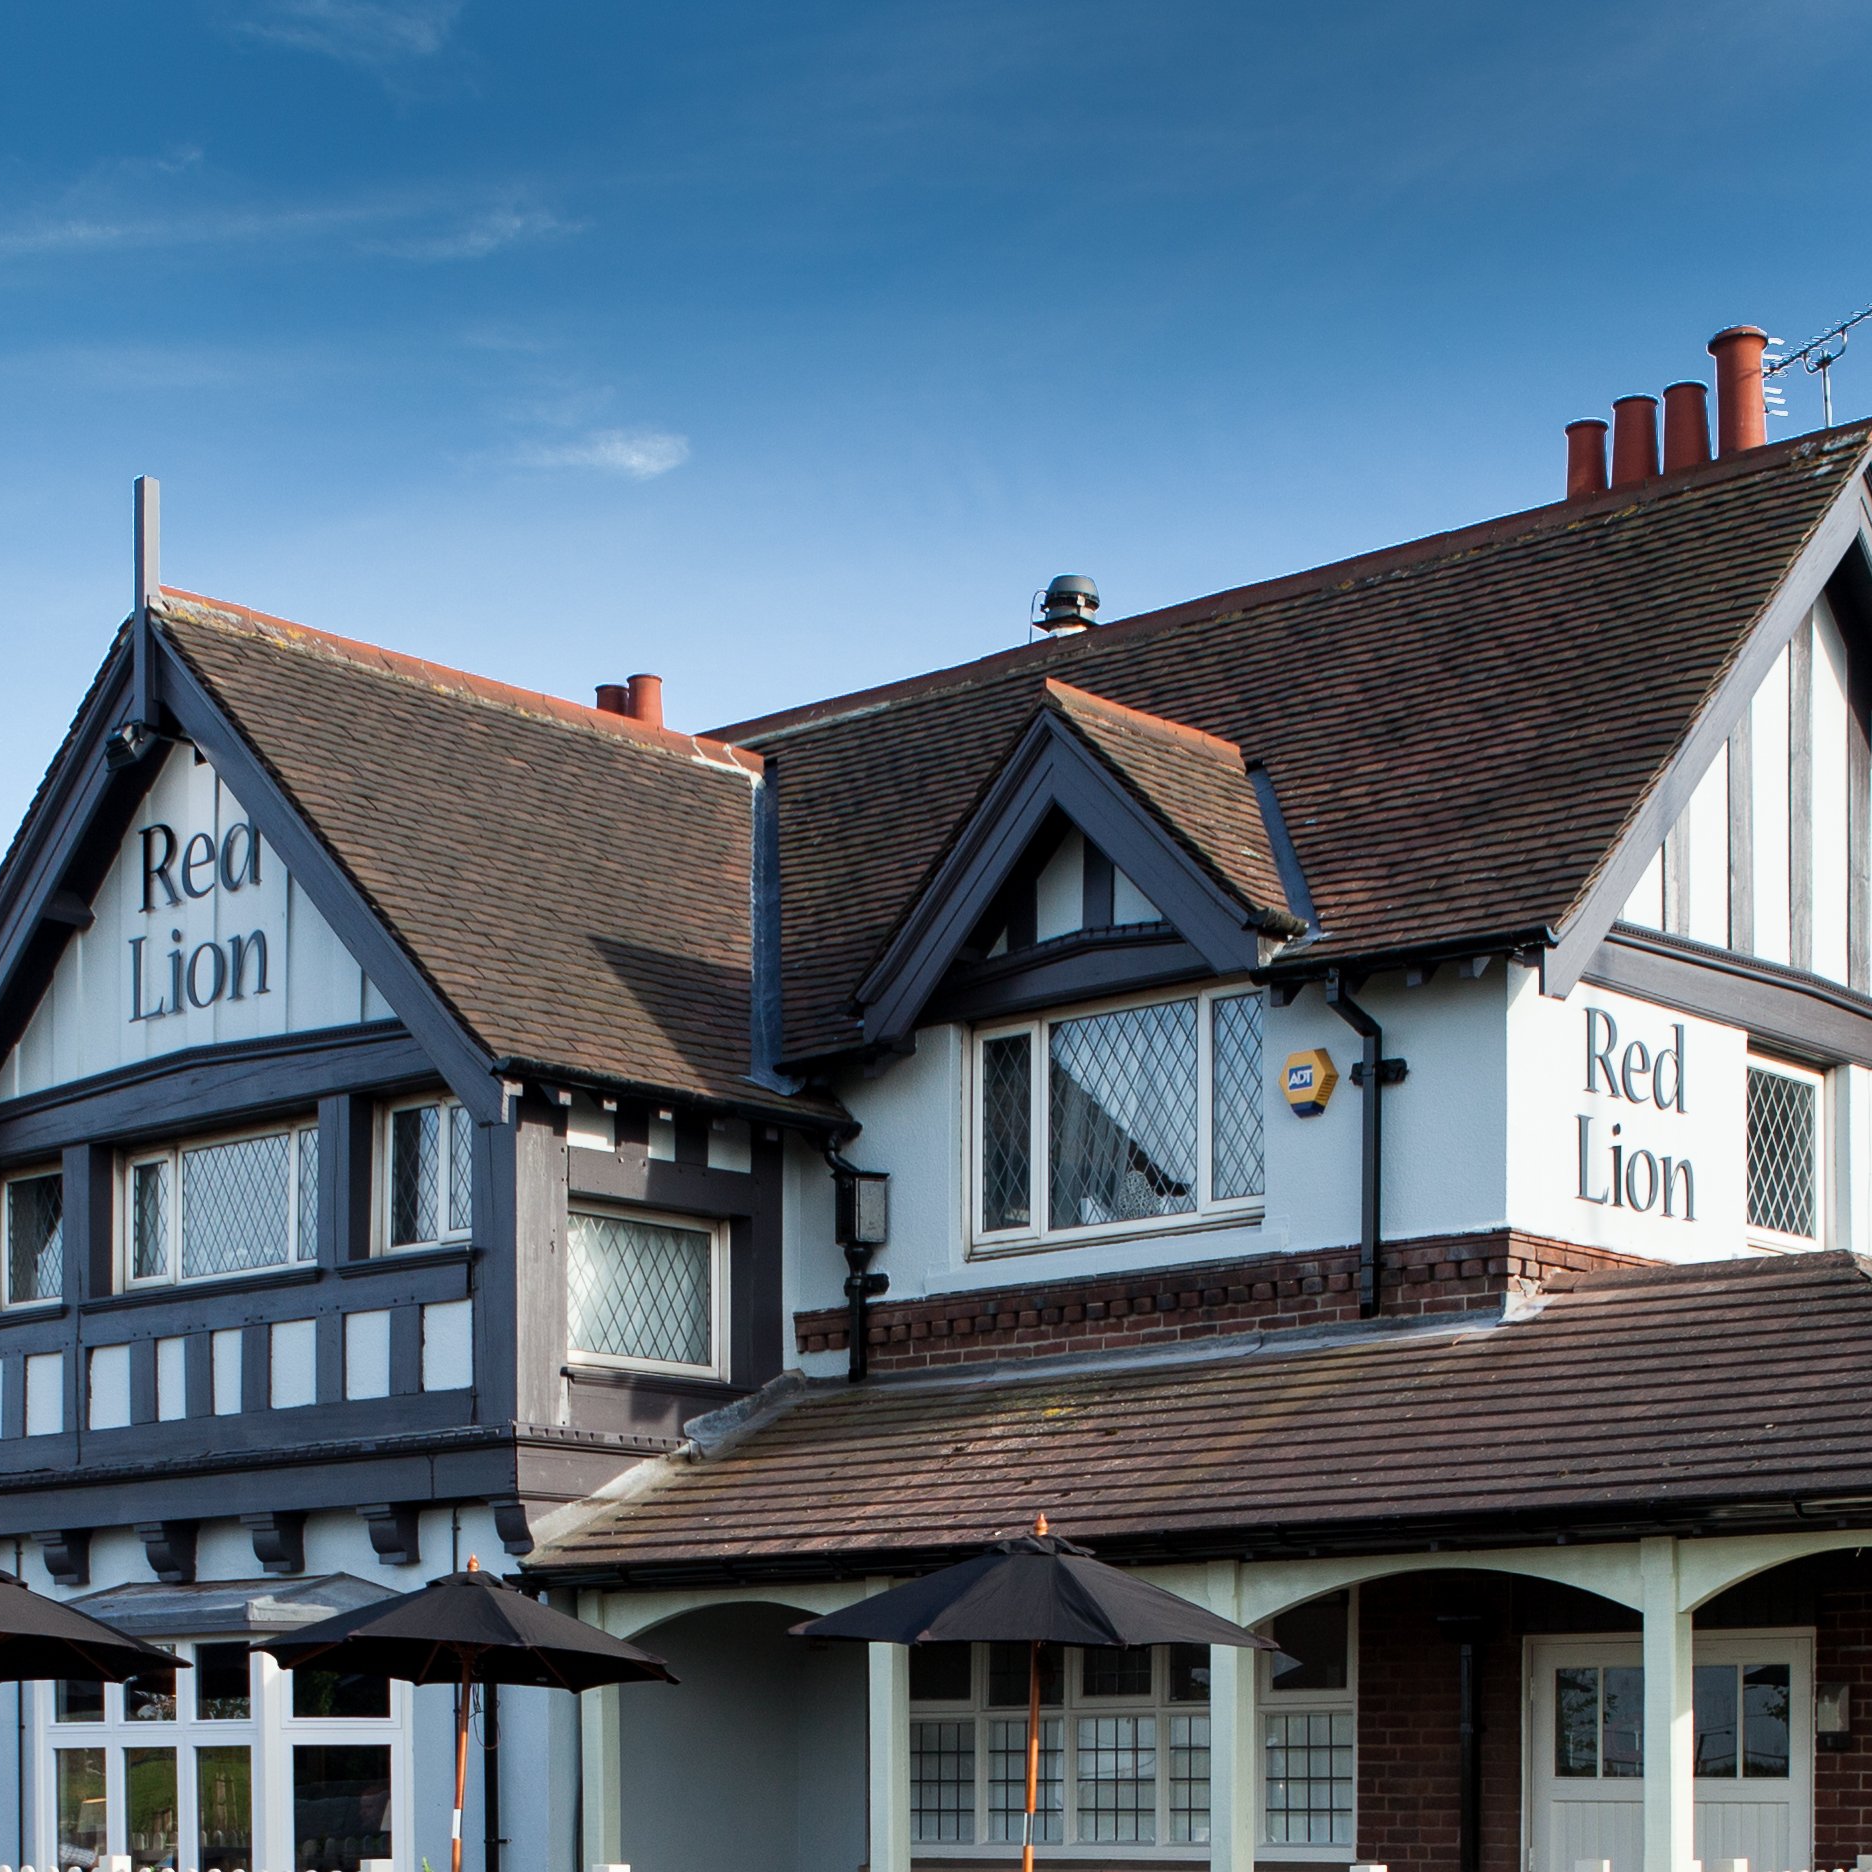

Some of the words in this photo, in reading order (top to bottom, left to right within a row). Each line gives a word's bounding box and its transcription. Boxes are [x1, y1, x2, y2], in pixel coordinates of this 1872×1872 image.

[138, 822, 262, 913] Red
[129, 929, 271, 1023] Lion
[1289, 1069, 1313, 1086] ADT
[1583, 1007, 1688, 1114] Red
[1574, 1114, 1697, 1222] Lion
